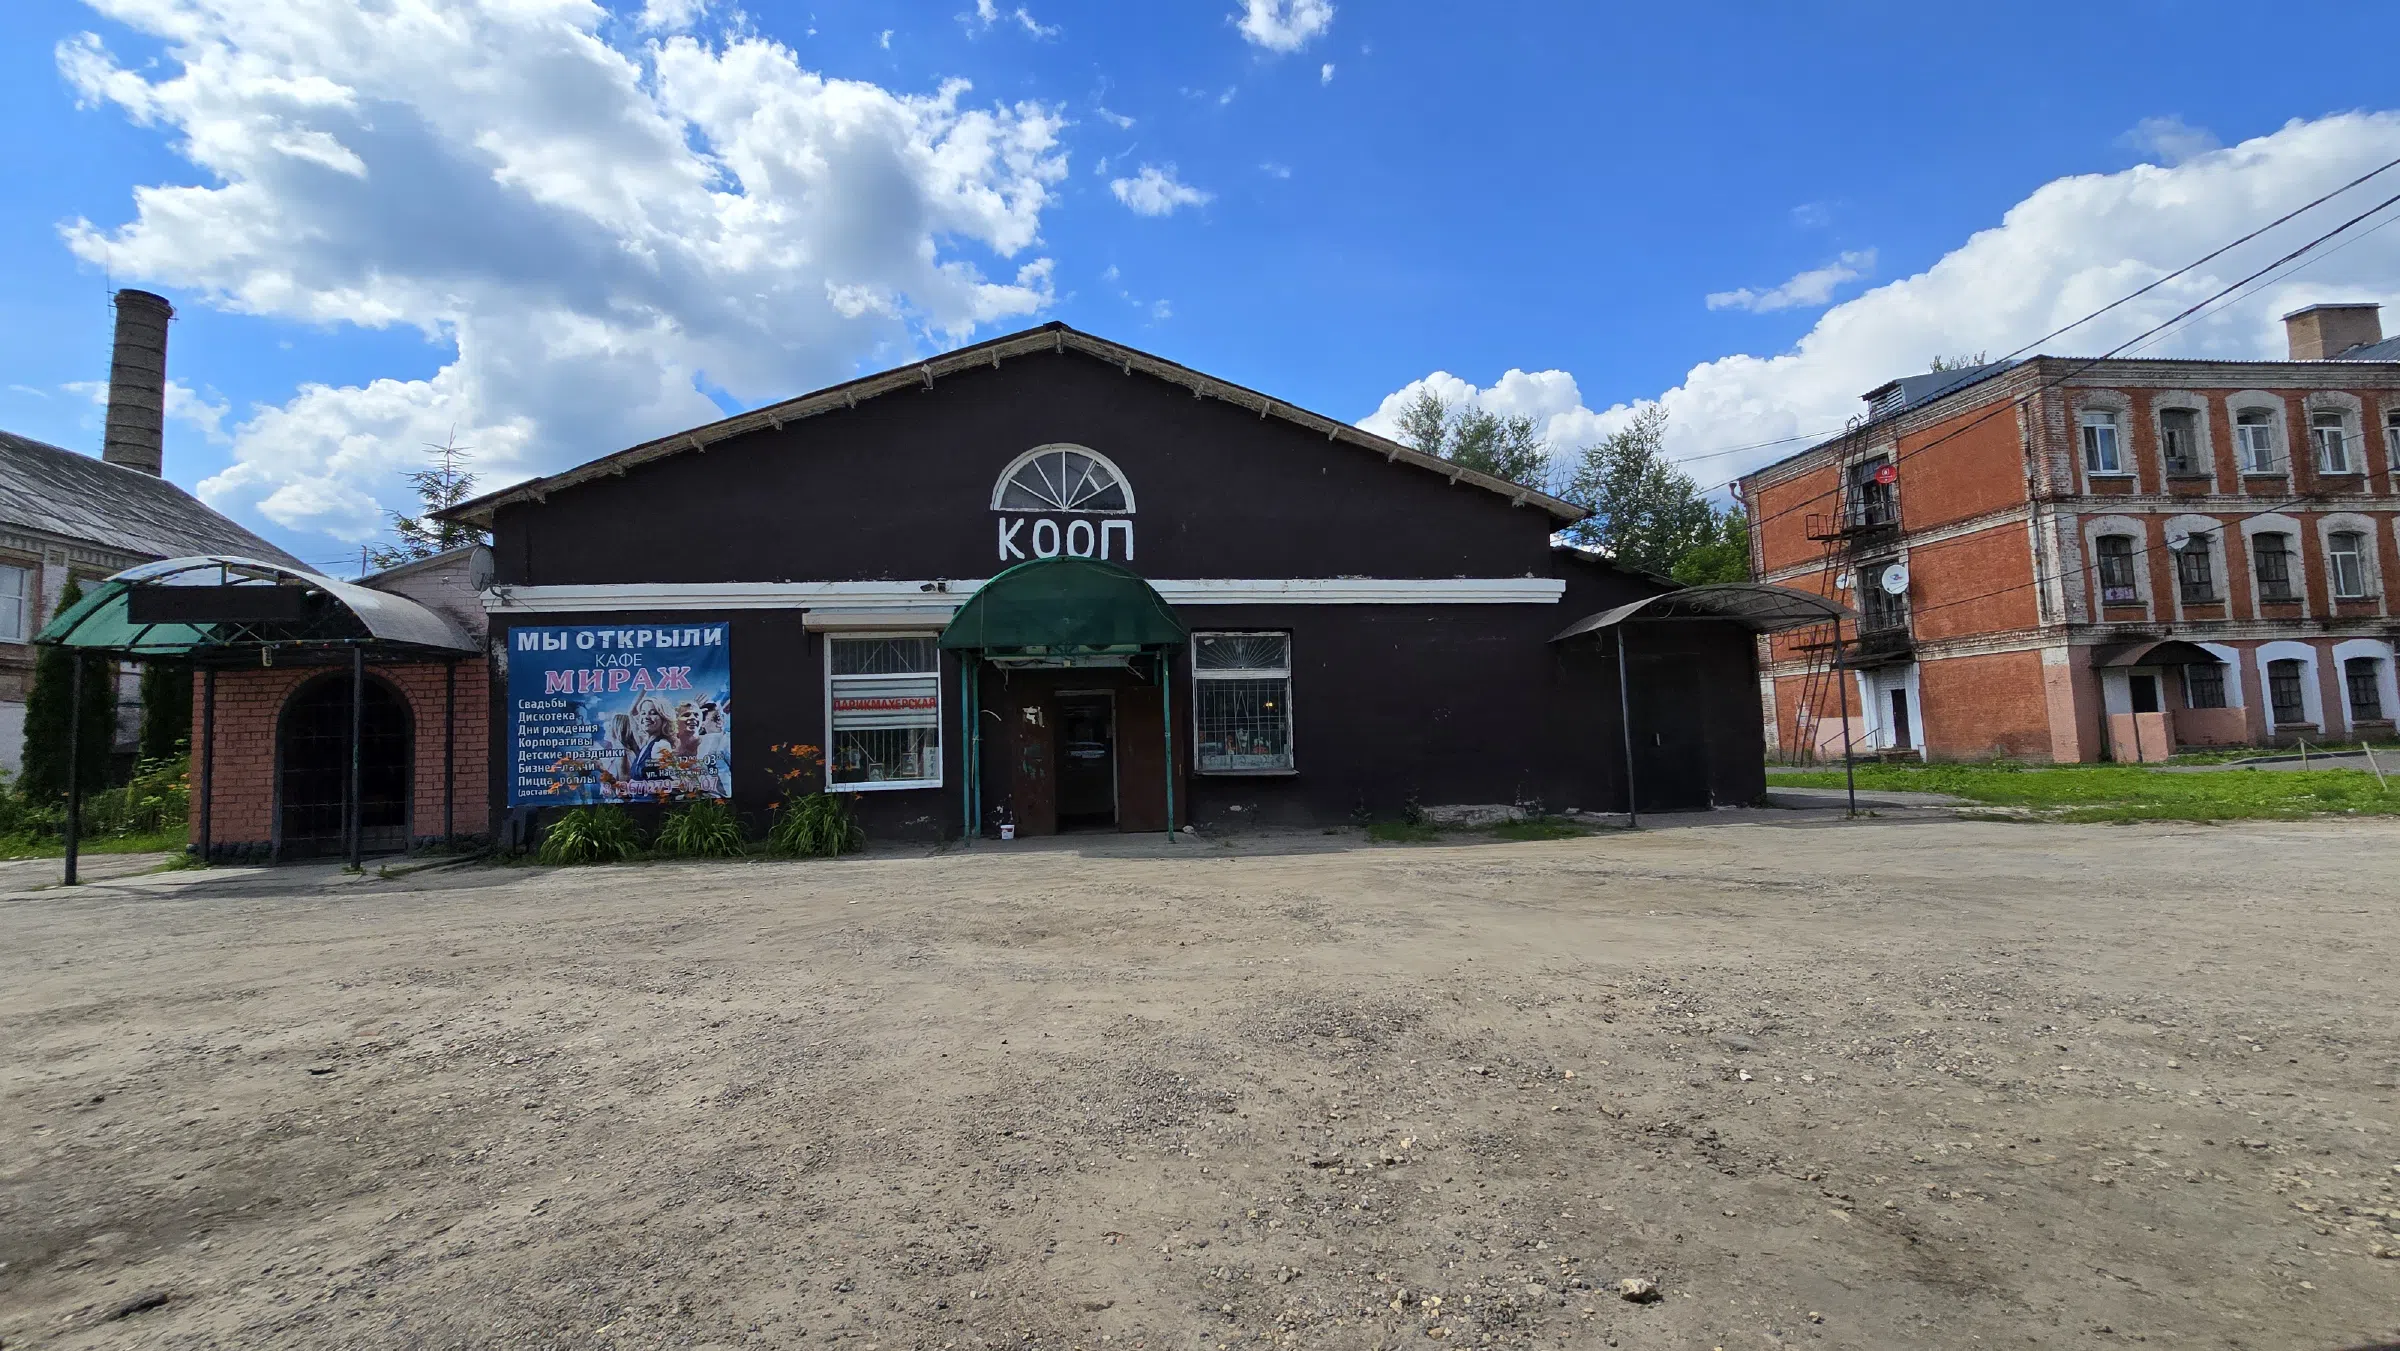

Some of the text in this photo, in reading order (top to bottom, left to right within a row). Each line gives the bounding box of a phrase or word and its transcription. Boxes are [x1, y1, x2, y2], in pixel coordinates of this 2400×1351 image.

[999, 517, 1134, 560] КООП
[518, 628, 722, 651] МЫ ОТКРЫЛИ
[595, 653, 642, 667] КАФЕ
[545, 666, 692, 694] МИРАЖ
[518, 698, 567, 709] Свадьбы
[833, 697, 936, 711] ПАРИКМАХЕРСКАЯ
[518, 711, 575, 723] Дискотека
[518, 724, 598, 736] Дни рождения
[518, 737, 593, 749] Корпоративы
[517, 749, 625, 762] Детские праздники
[645, 770, 657, 779] ул.
